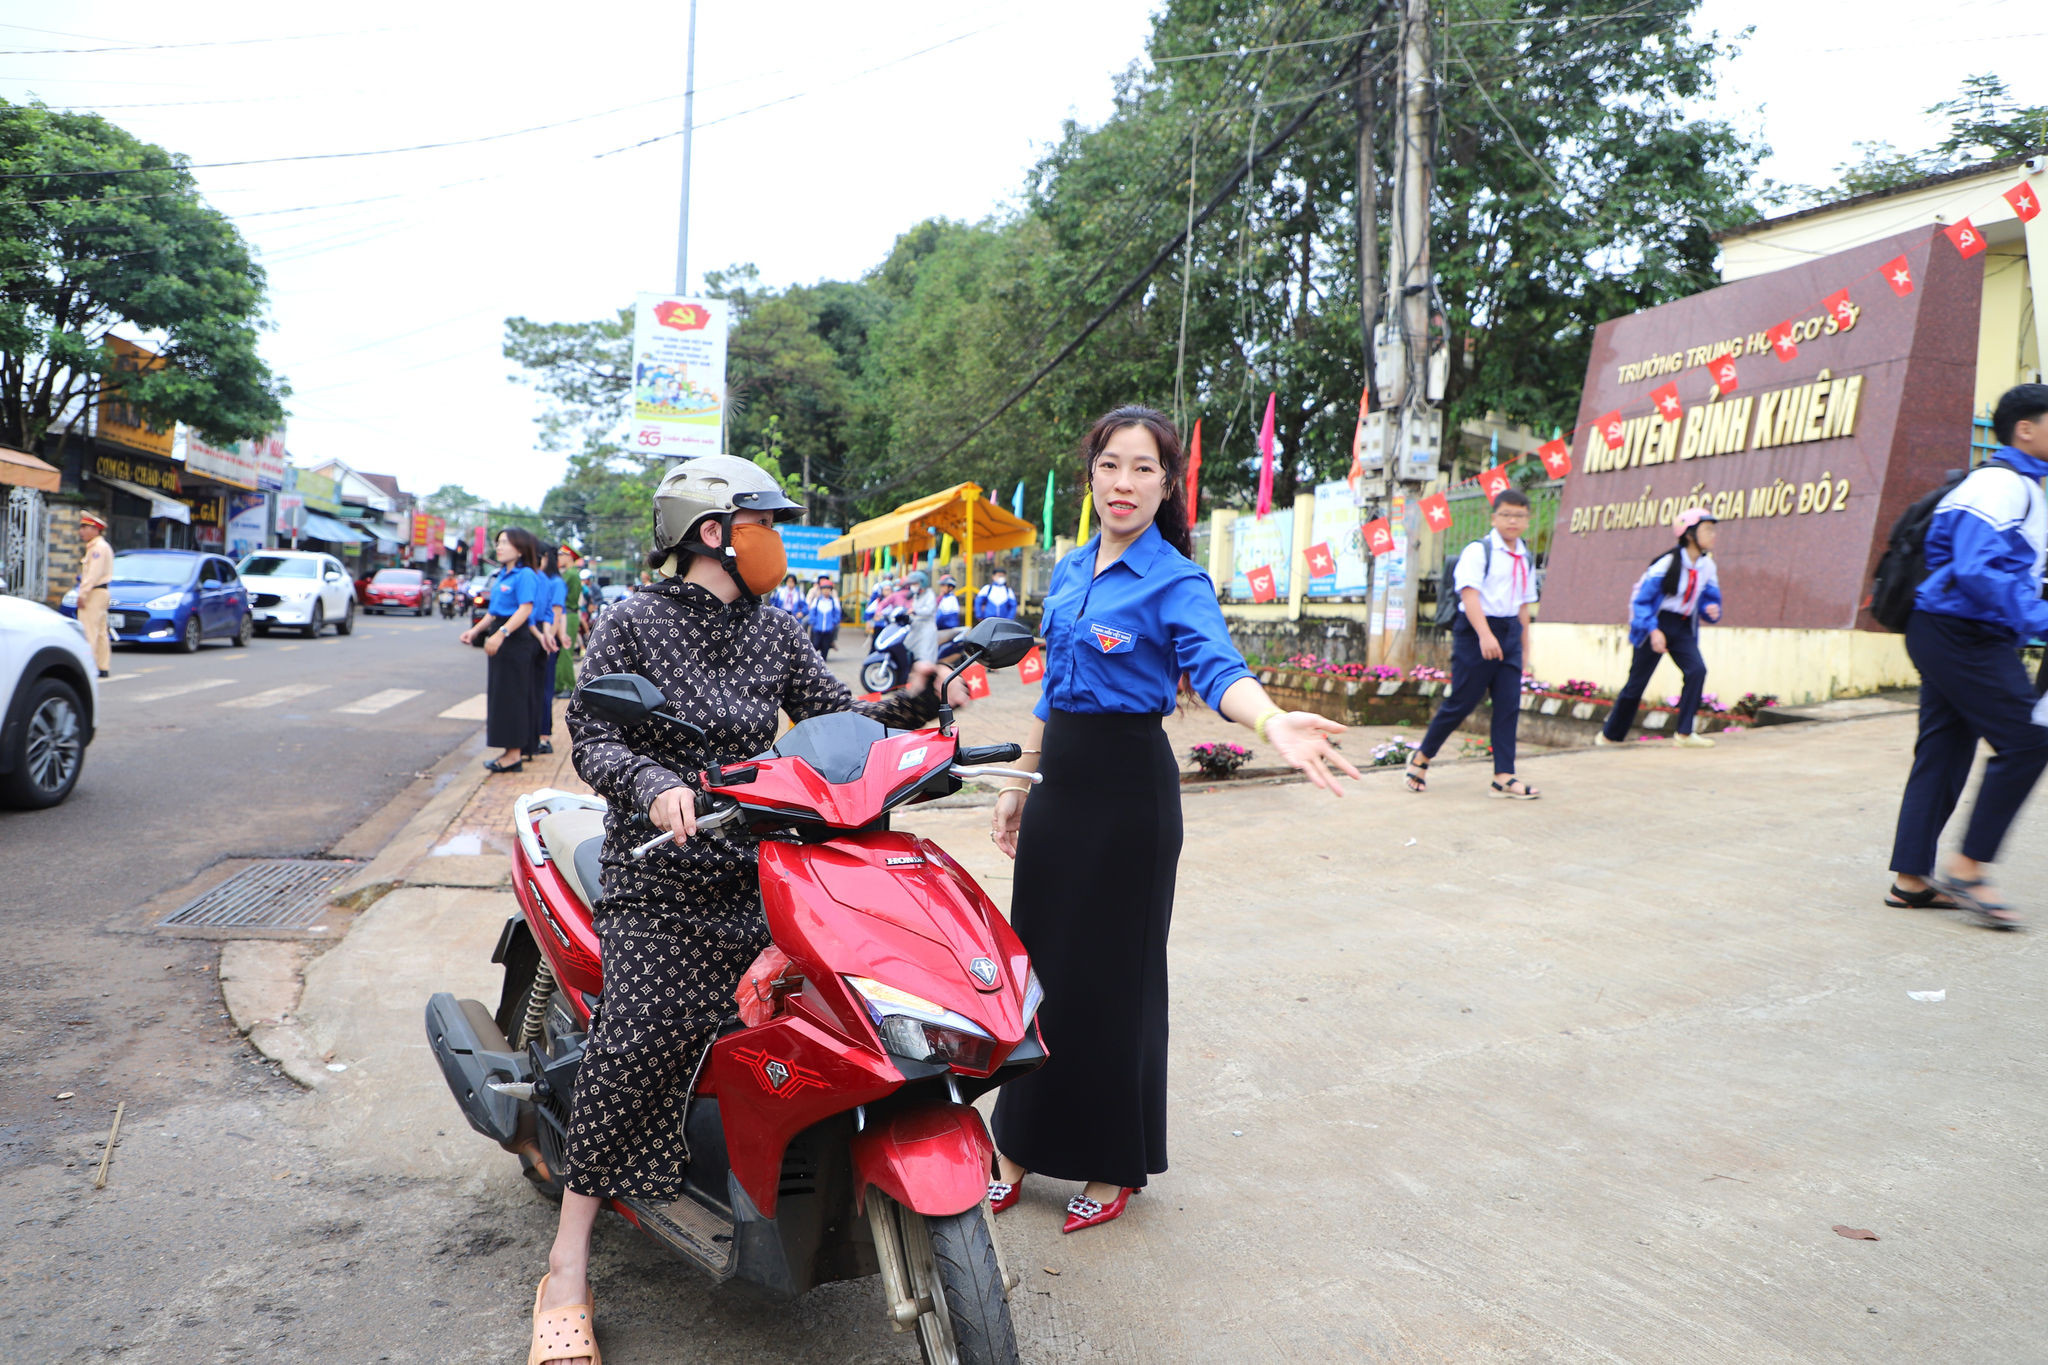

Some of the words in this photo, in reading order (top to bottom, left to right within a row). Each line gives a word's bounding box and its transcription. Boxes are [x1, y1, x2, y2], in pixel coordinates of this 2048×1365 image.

[1686, 337, 1744, 369] TRUNG
[1745, 330, 1775, 356] HỌ
[1751, 368, 1864, 450] KHIÊM
[638, 430, 661, 447] 5G
[1569, 504, 1604, 538] ĐẠT
[1603, 485, 1659, 531] CHUẨN
[1711, 490, 1745, 521] GIA
[1747, 478, 1796, 518] MỨC
[1831, 479, 1850, 512] 2
[627, 930, 678, 944] Supreme
[596, 1074, 644, 1098] Supreme
[568, 1155, 611, 1175] Supreme
